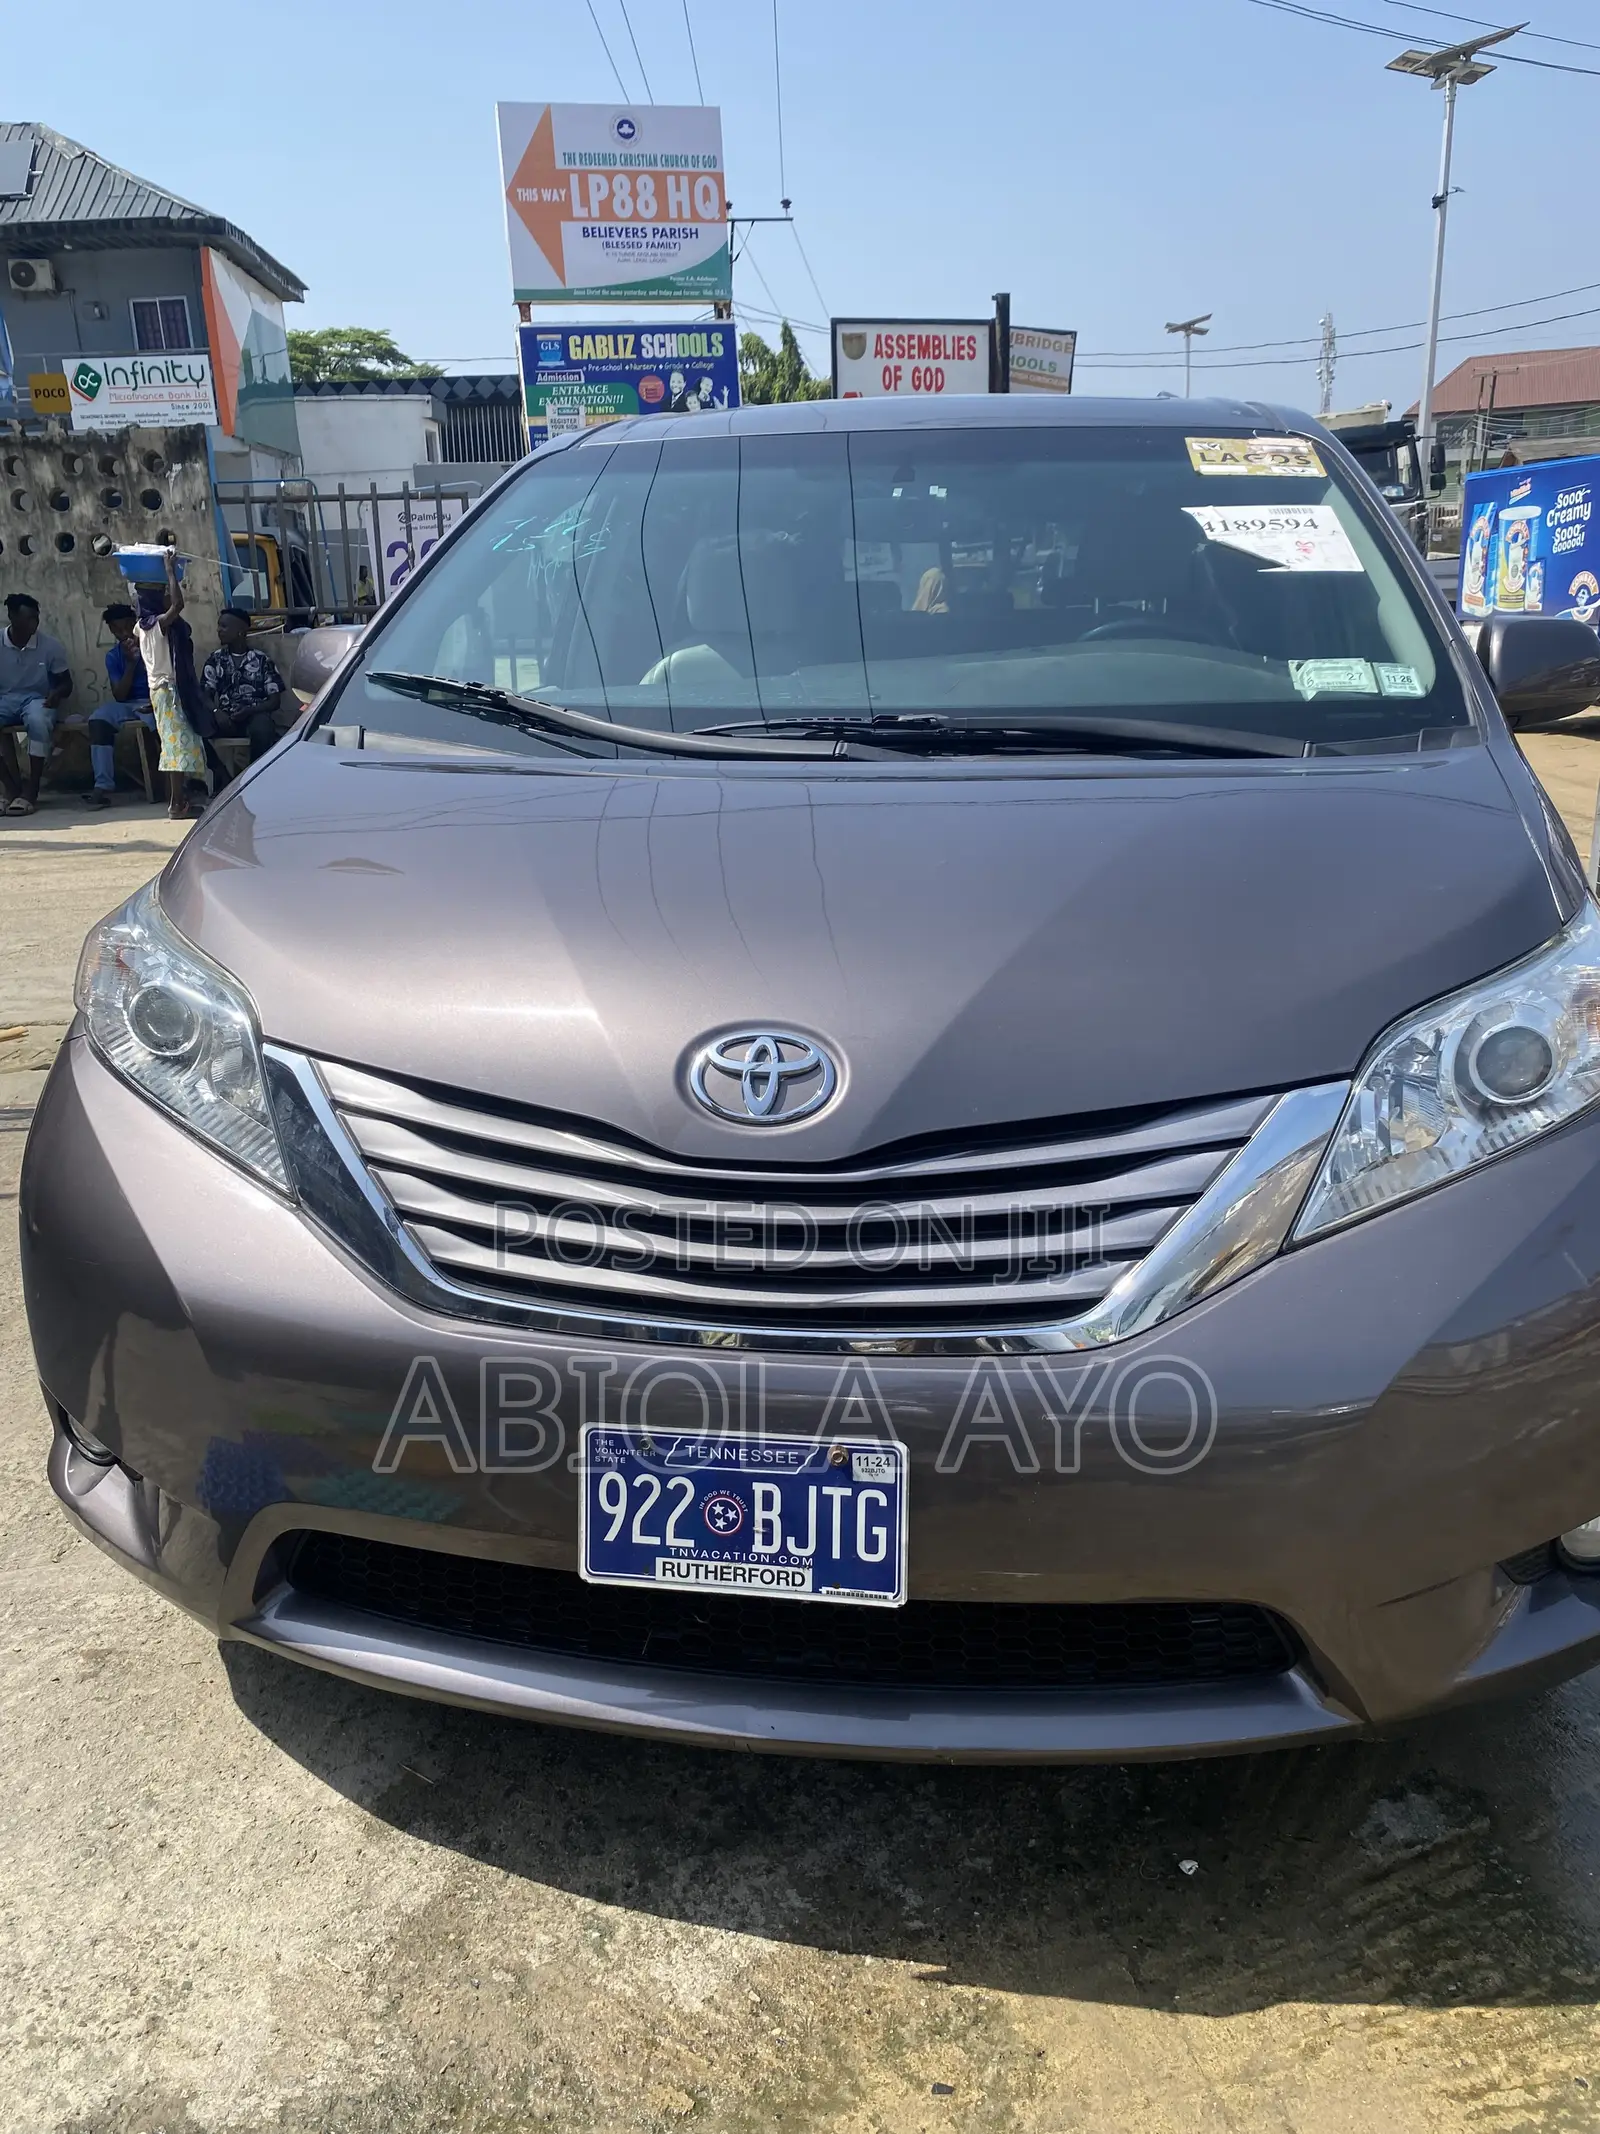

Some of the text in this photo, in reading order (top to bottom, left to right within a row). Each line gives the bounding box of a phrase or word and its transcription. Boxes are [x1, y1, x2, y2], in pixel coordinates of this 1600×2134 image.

[563, 152, 718, 169] THE REDEEMED CHRISTIAN CHURCH OF GOD
[516, 187, 567, 202] THIS WAY
[569, 172, 721, 221] LP88 HQ
[582, 226, 700, 240] BELIEVERS PARISH
[602, 240, 682, 252] (BLESSED FAMILY)
[540, 341, 560, 351] GLS
[568, 332, 724, 361] GABLIZ SCHOOLS
[874, 333, 977, 361] ASSEMBLIES
[587, 361, 715, 372] Pre-school Nursery Grade College
[103, 359, 205, 391] Infinity
[536, 371, 581, 383] Admission
[882, 364, 945, 393] OF GOD
[34, 387, 66, 399] POCO
[108, 390, 209, 401] Microfinance Bank Ltd.
[551, 384, 609, 396] ENTRANCE
[171, 401, 212, 410] Since 2001
[538, 394, 624, 407] EXAMINATION!!!
[595, 406, 615, 414] INTO
[1546, 502, 1592, 528] Creamy
[1554, 523, 1582, 543] Sooo
[594, 1438, 615, 1447] THE
[594, 1447, 657, 1457] VOLUNTEER
[685, 1444, 800, 1465] TENNESSEE
[594, 1456, 626, 1464] STATE
[855, 1455, 891, 1468] 11-24
[698, 1489, 749, 1513] IN GOD WE TRUST
[599, 1471, 889, 1563] 922 BJTG
[669, 1546, 814, 1567] TNVACATION.COM
[662, 1560, 807, 1588] RUTHERFORD
